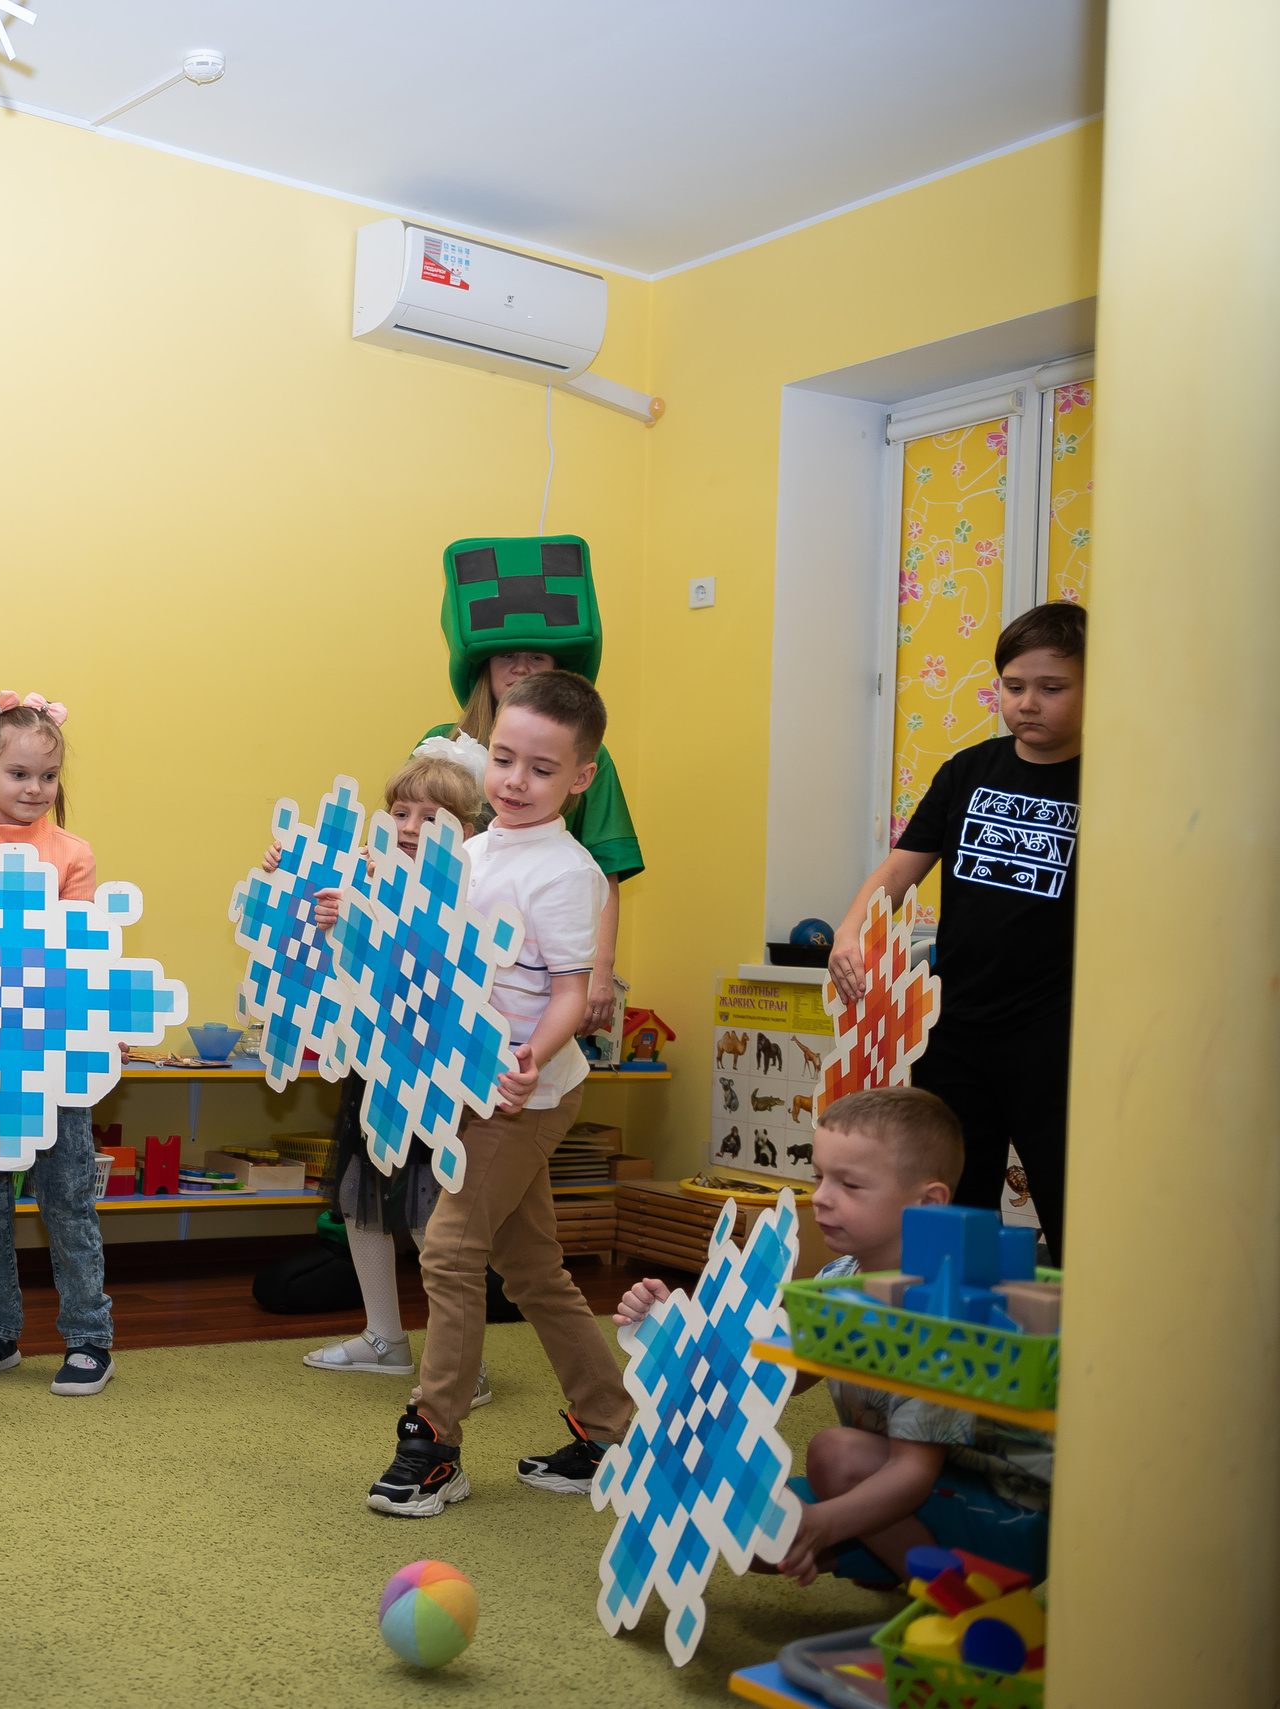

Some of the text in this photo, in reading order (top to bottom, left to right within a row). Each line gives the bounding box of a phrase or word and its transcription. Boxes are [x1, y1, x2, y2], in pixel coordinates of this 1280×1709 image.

[728, 984, 780, 998] ЖИВОТНЫЕ
[719, 996, 756, 1009] ЖАРКИХ
[758, 998, 788, 1012] СТРАН
